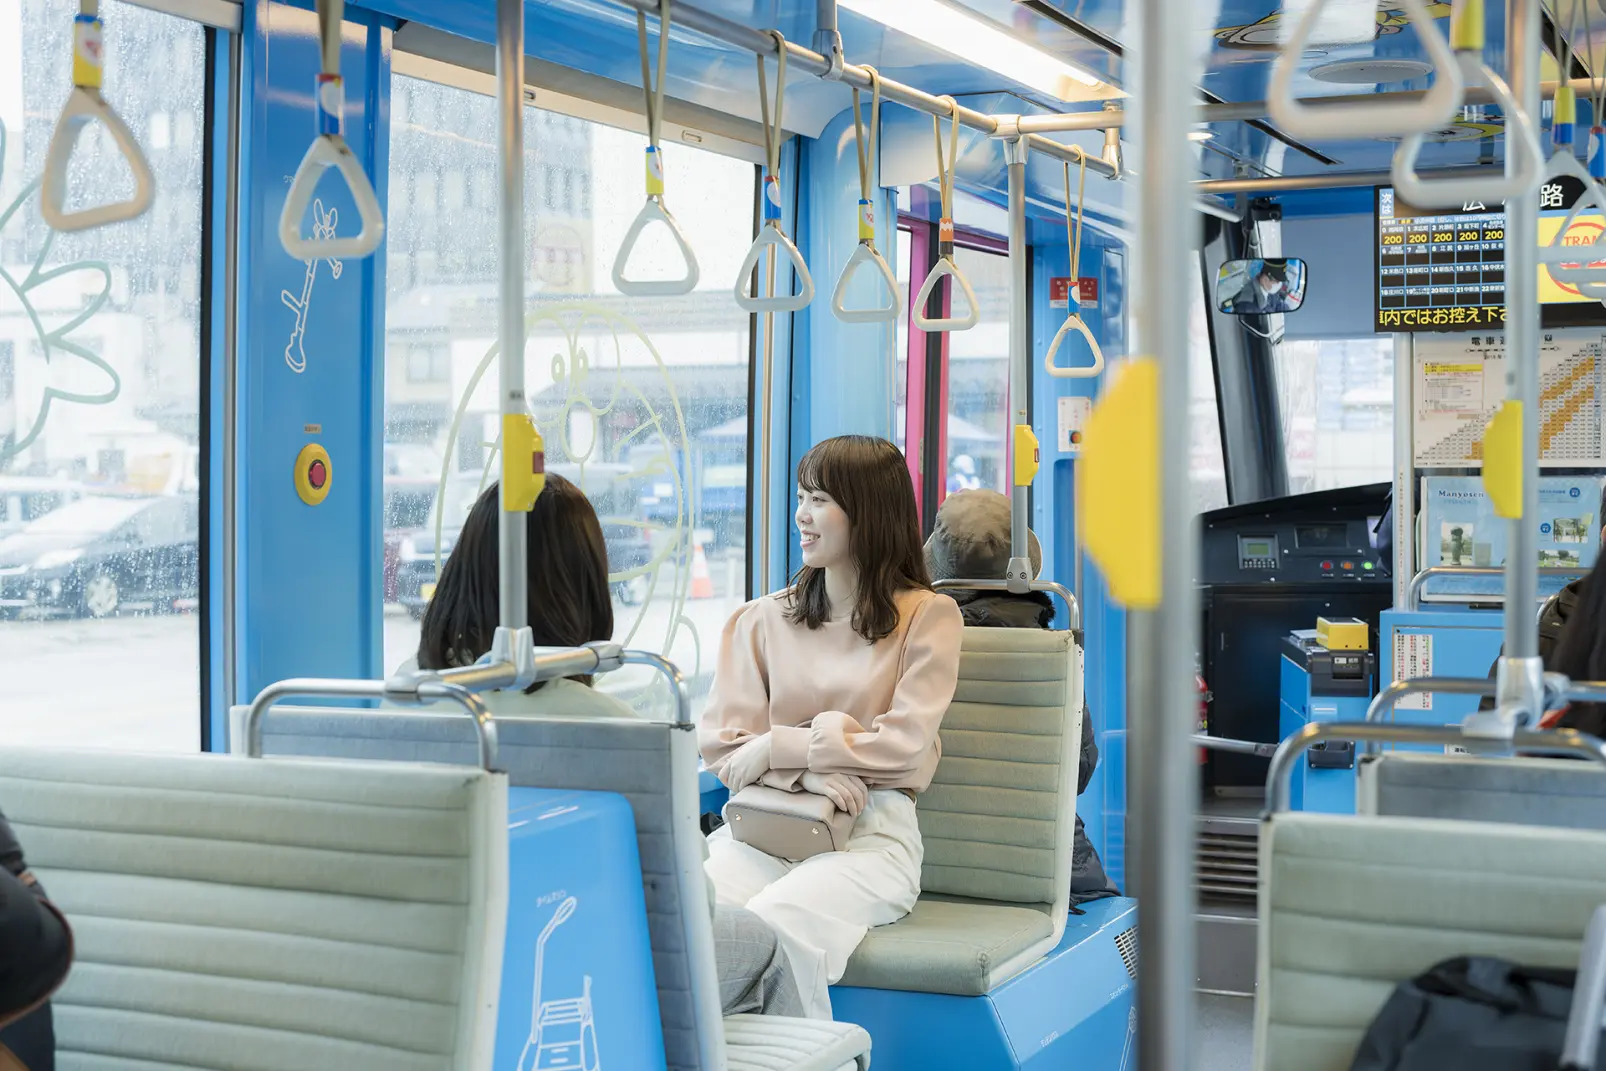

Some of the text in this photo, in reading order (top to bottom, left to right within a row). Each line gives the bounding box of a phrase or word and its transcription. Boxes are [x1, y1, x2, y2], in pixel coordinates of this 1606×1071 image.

[1381, 193, 1392, 216] 次は
[1409, 234, 1427, 243] 200
[1434, 233, 1452, 242] 200
[1460, 232, 1478, 240] 200
[1485, 230, 1504, 240] 200
[1384, 236, 1402, 244] 200
[1379, 306, 1509, 326] 内ではお控え下さ
